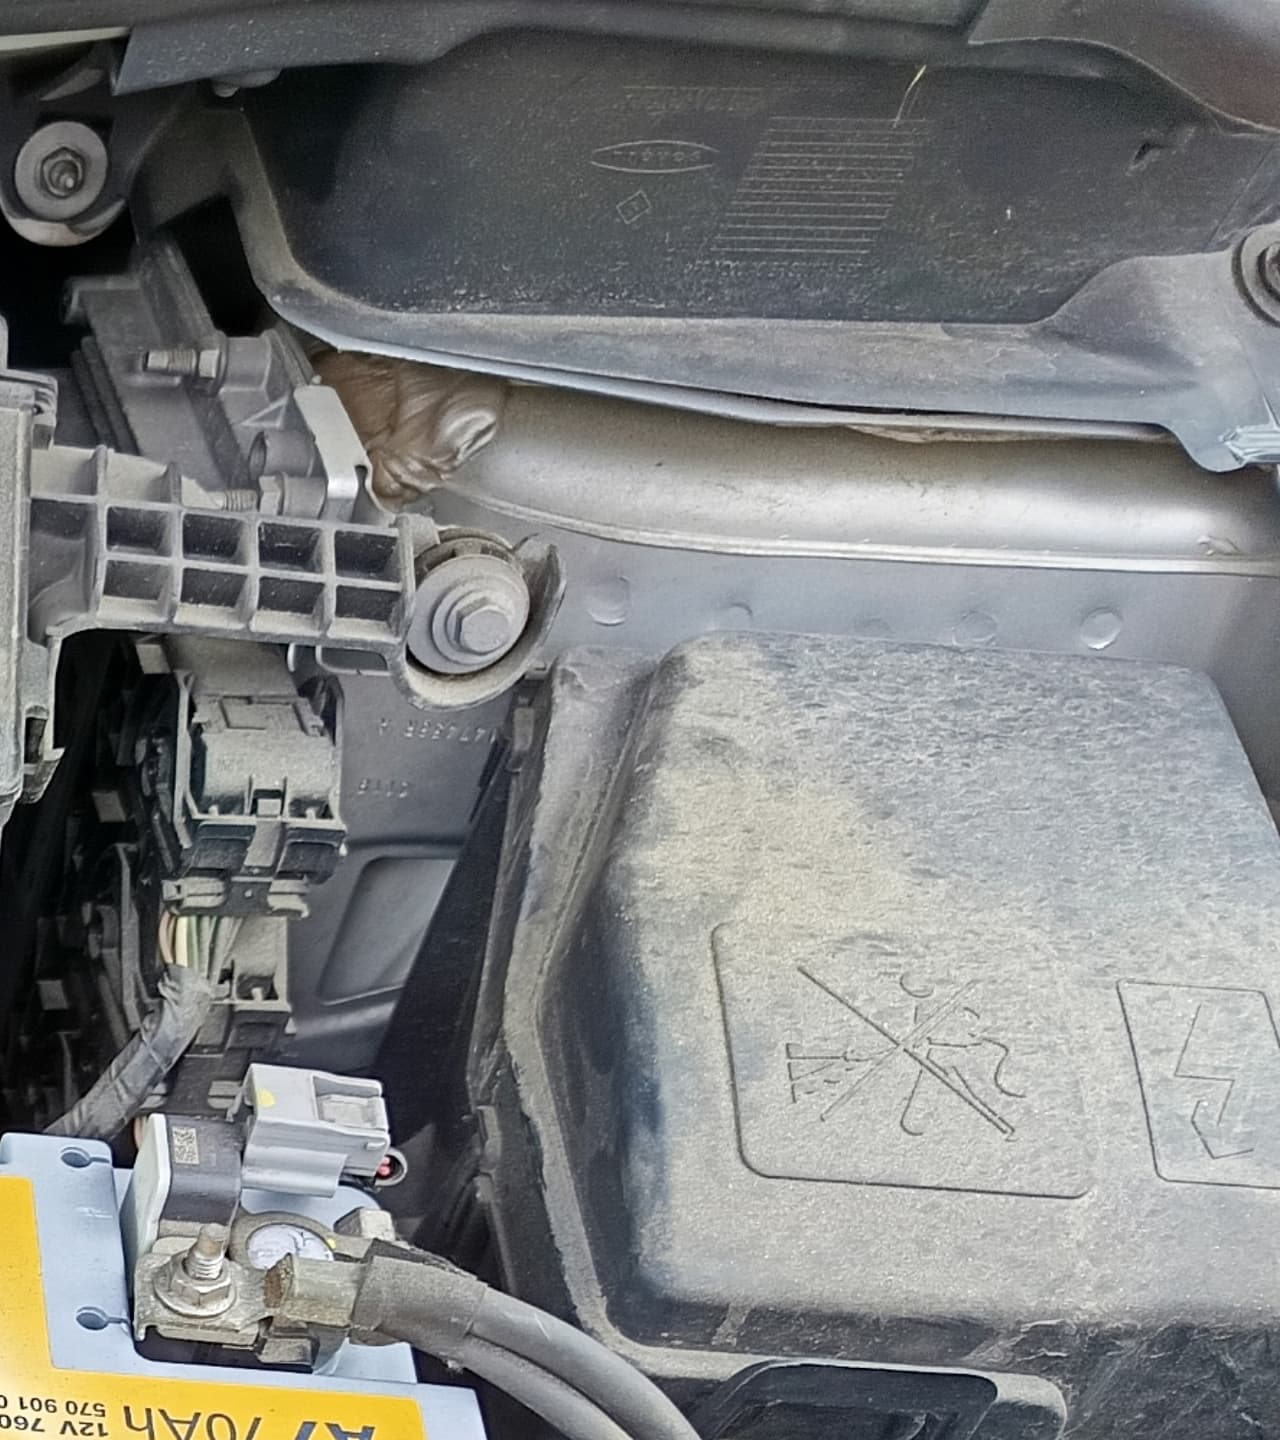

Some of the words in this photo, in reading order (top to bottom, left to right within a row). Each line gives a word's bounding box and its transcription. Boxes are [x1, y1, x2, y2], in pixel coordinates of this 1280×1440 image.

[17, 1395, 58, 1415] 901
[67, 1400, 106, 1418] 570
[59, 1418, 109, 1439] 12V
